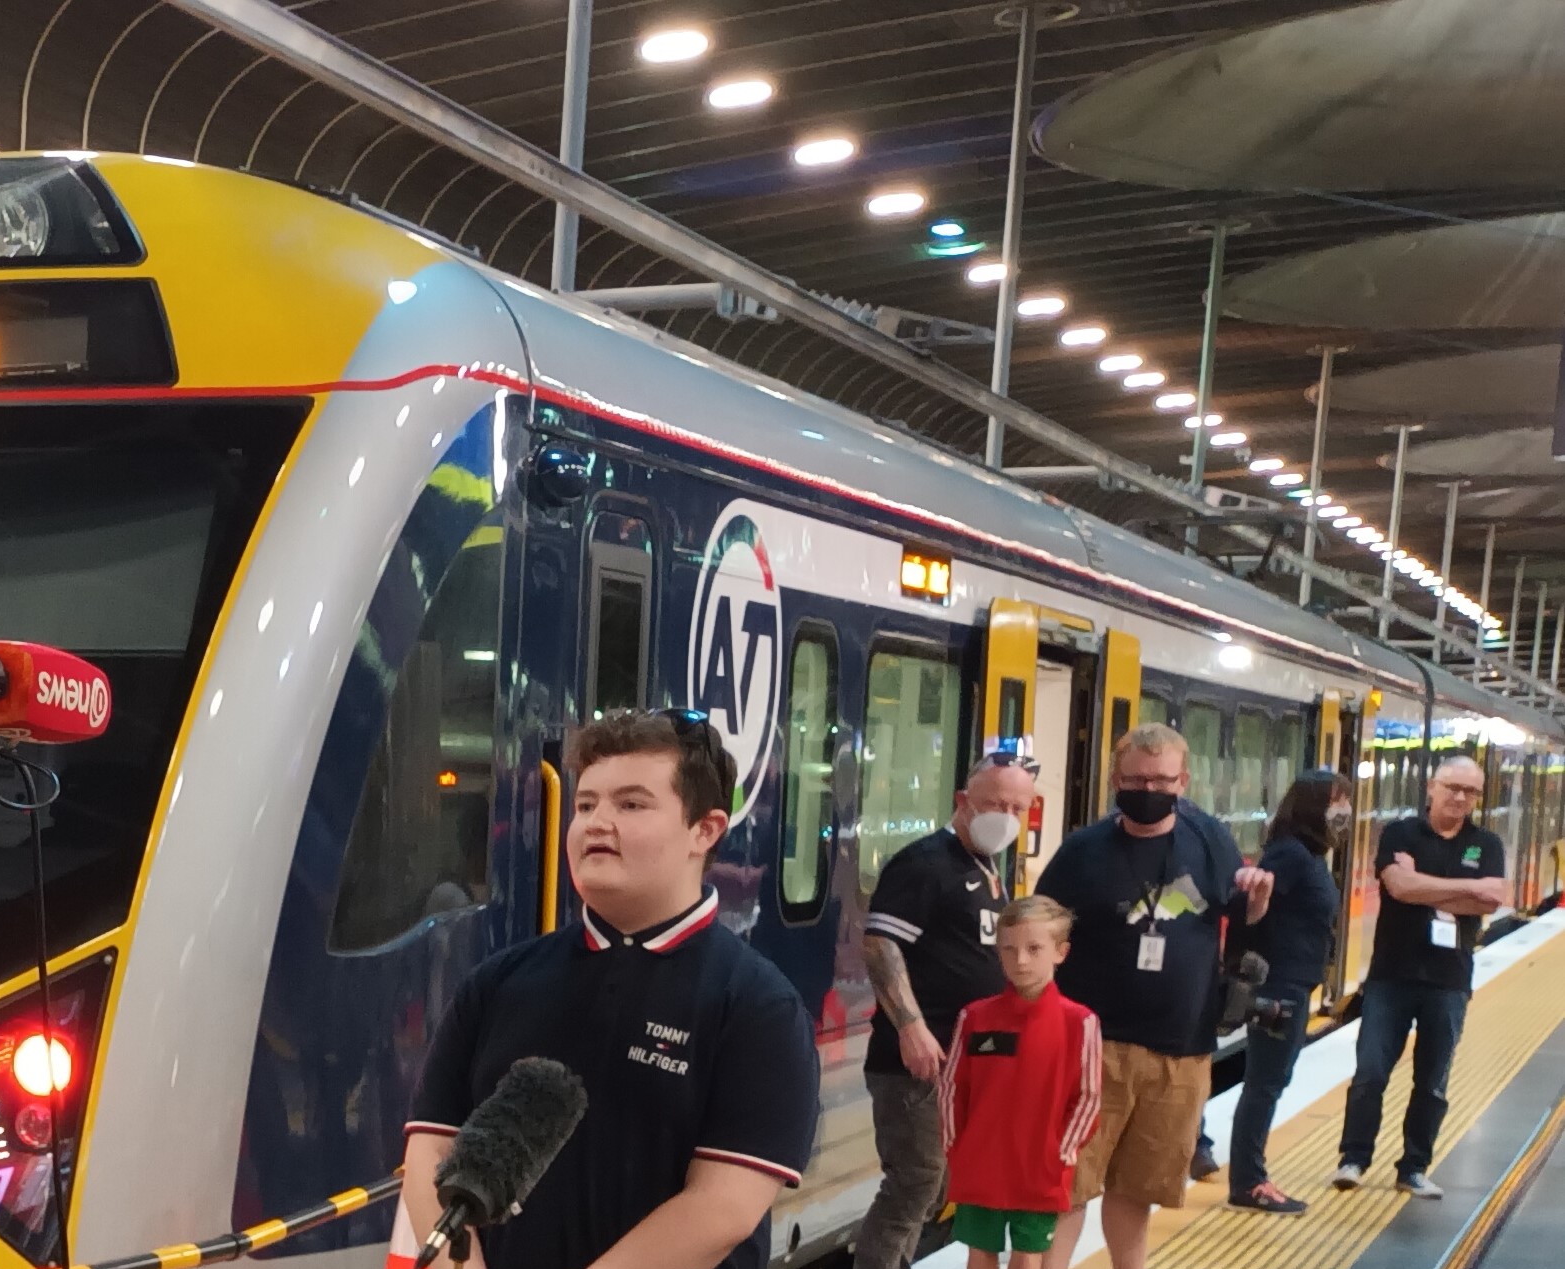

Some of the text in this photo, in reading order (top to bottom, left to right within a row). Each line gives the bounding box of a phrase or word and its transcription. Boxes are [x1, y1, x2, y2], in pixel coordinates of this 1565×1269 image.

[699, 595, 777, 736] AT
[645, 1021, 691, 1046] TOMMY
[627, 1046, 689, 1076] HILFIGER
